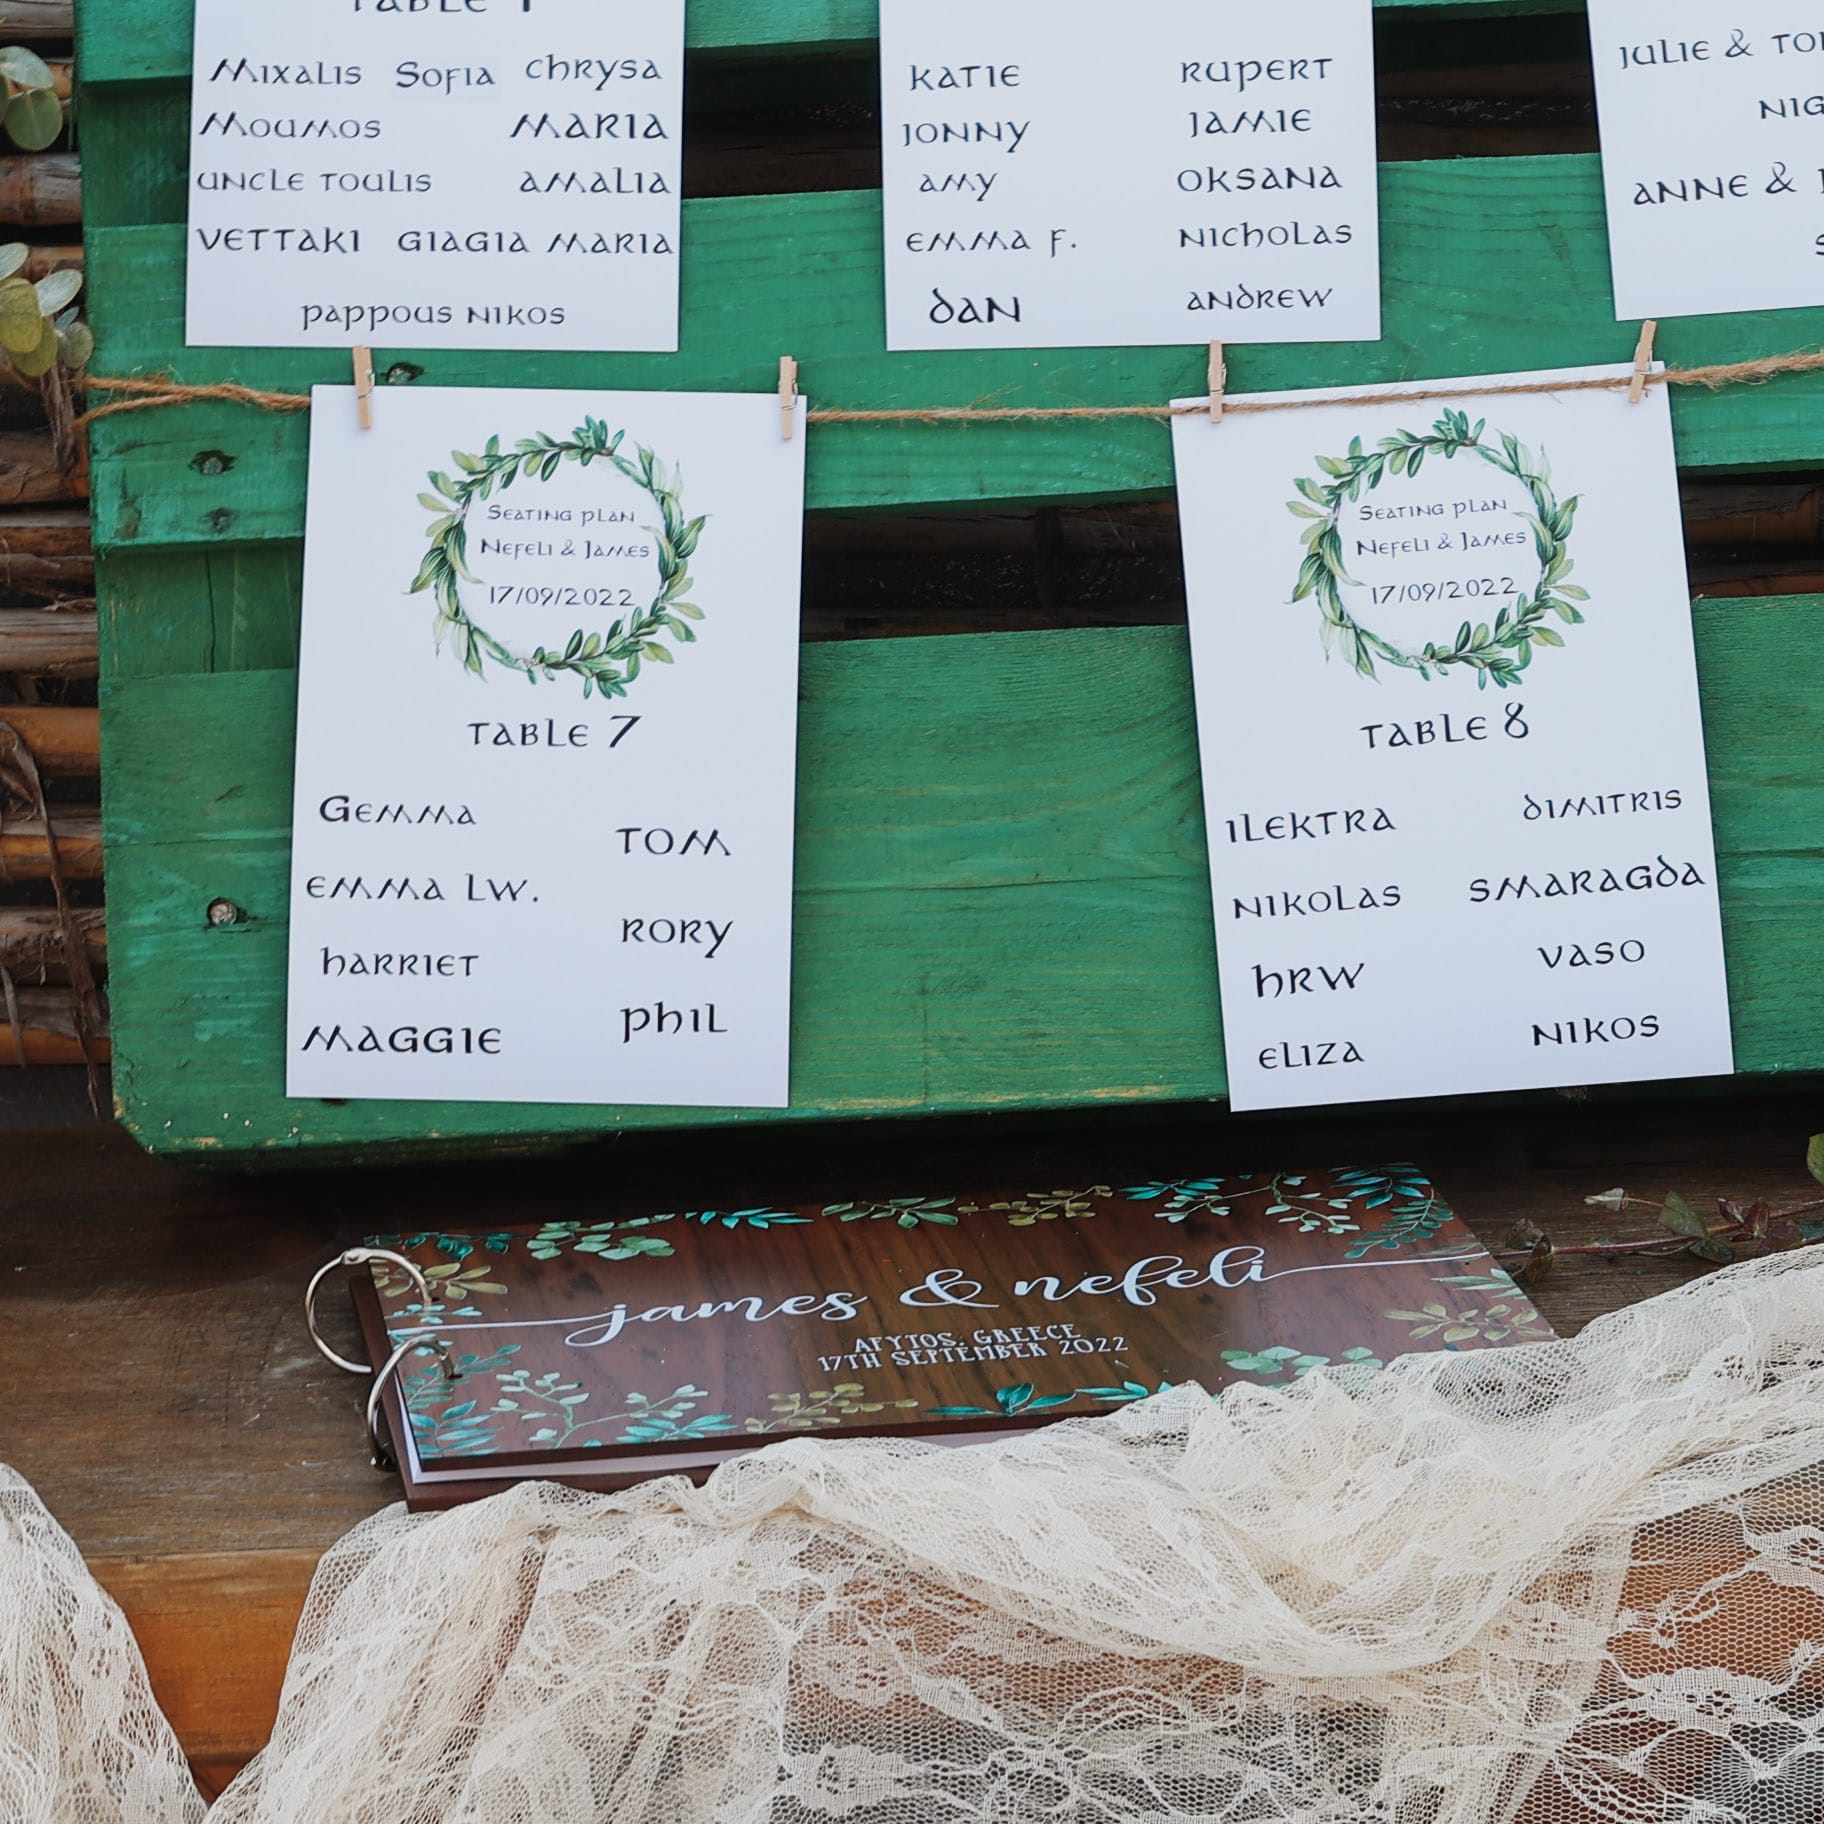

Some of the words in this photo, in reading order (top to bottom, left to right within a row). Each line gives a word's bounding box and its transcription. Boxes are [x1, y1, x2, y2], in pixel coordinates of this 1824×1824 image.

[1725, 29, 1753, 57] &
[1765, 162, 1796, 194] &
[561, 541, 575, 556] &
[1437, 533, 1452, 549] &
[491, 586, 635, 606] 17/09/2022
[1372, 577, 1519, 604] 17/09/2022
[468, 719, 588, 747] TABLE
[609, 716, 641, 748] 7
[1360, 714, 1487, 748] TABLE
[1505, 703, 1528, 739] 8
[565, 1291, 869, 1347] james
[898, 1268, 1000, 1308] &
[1014, 1245, 1276, 1307] nefeli
[972, 1323, 1081, 1345] GREECE
[817, 1352, 883, 1372] 17TH
[890, 1342, 1047, 1367] SEPTEMBER
[1059, 1336, 1129, 1356] 2022
